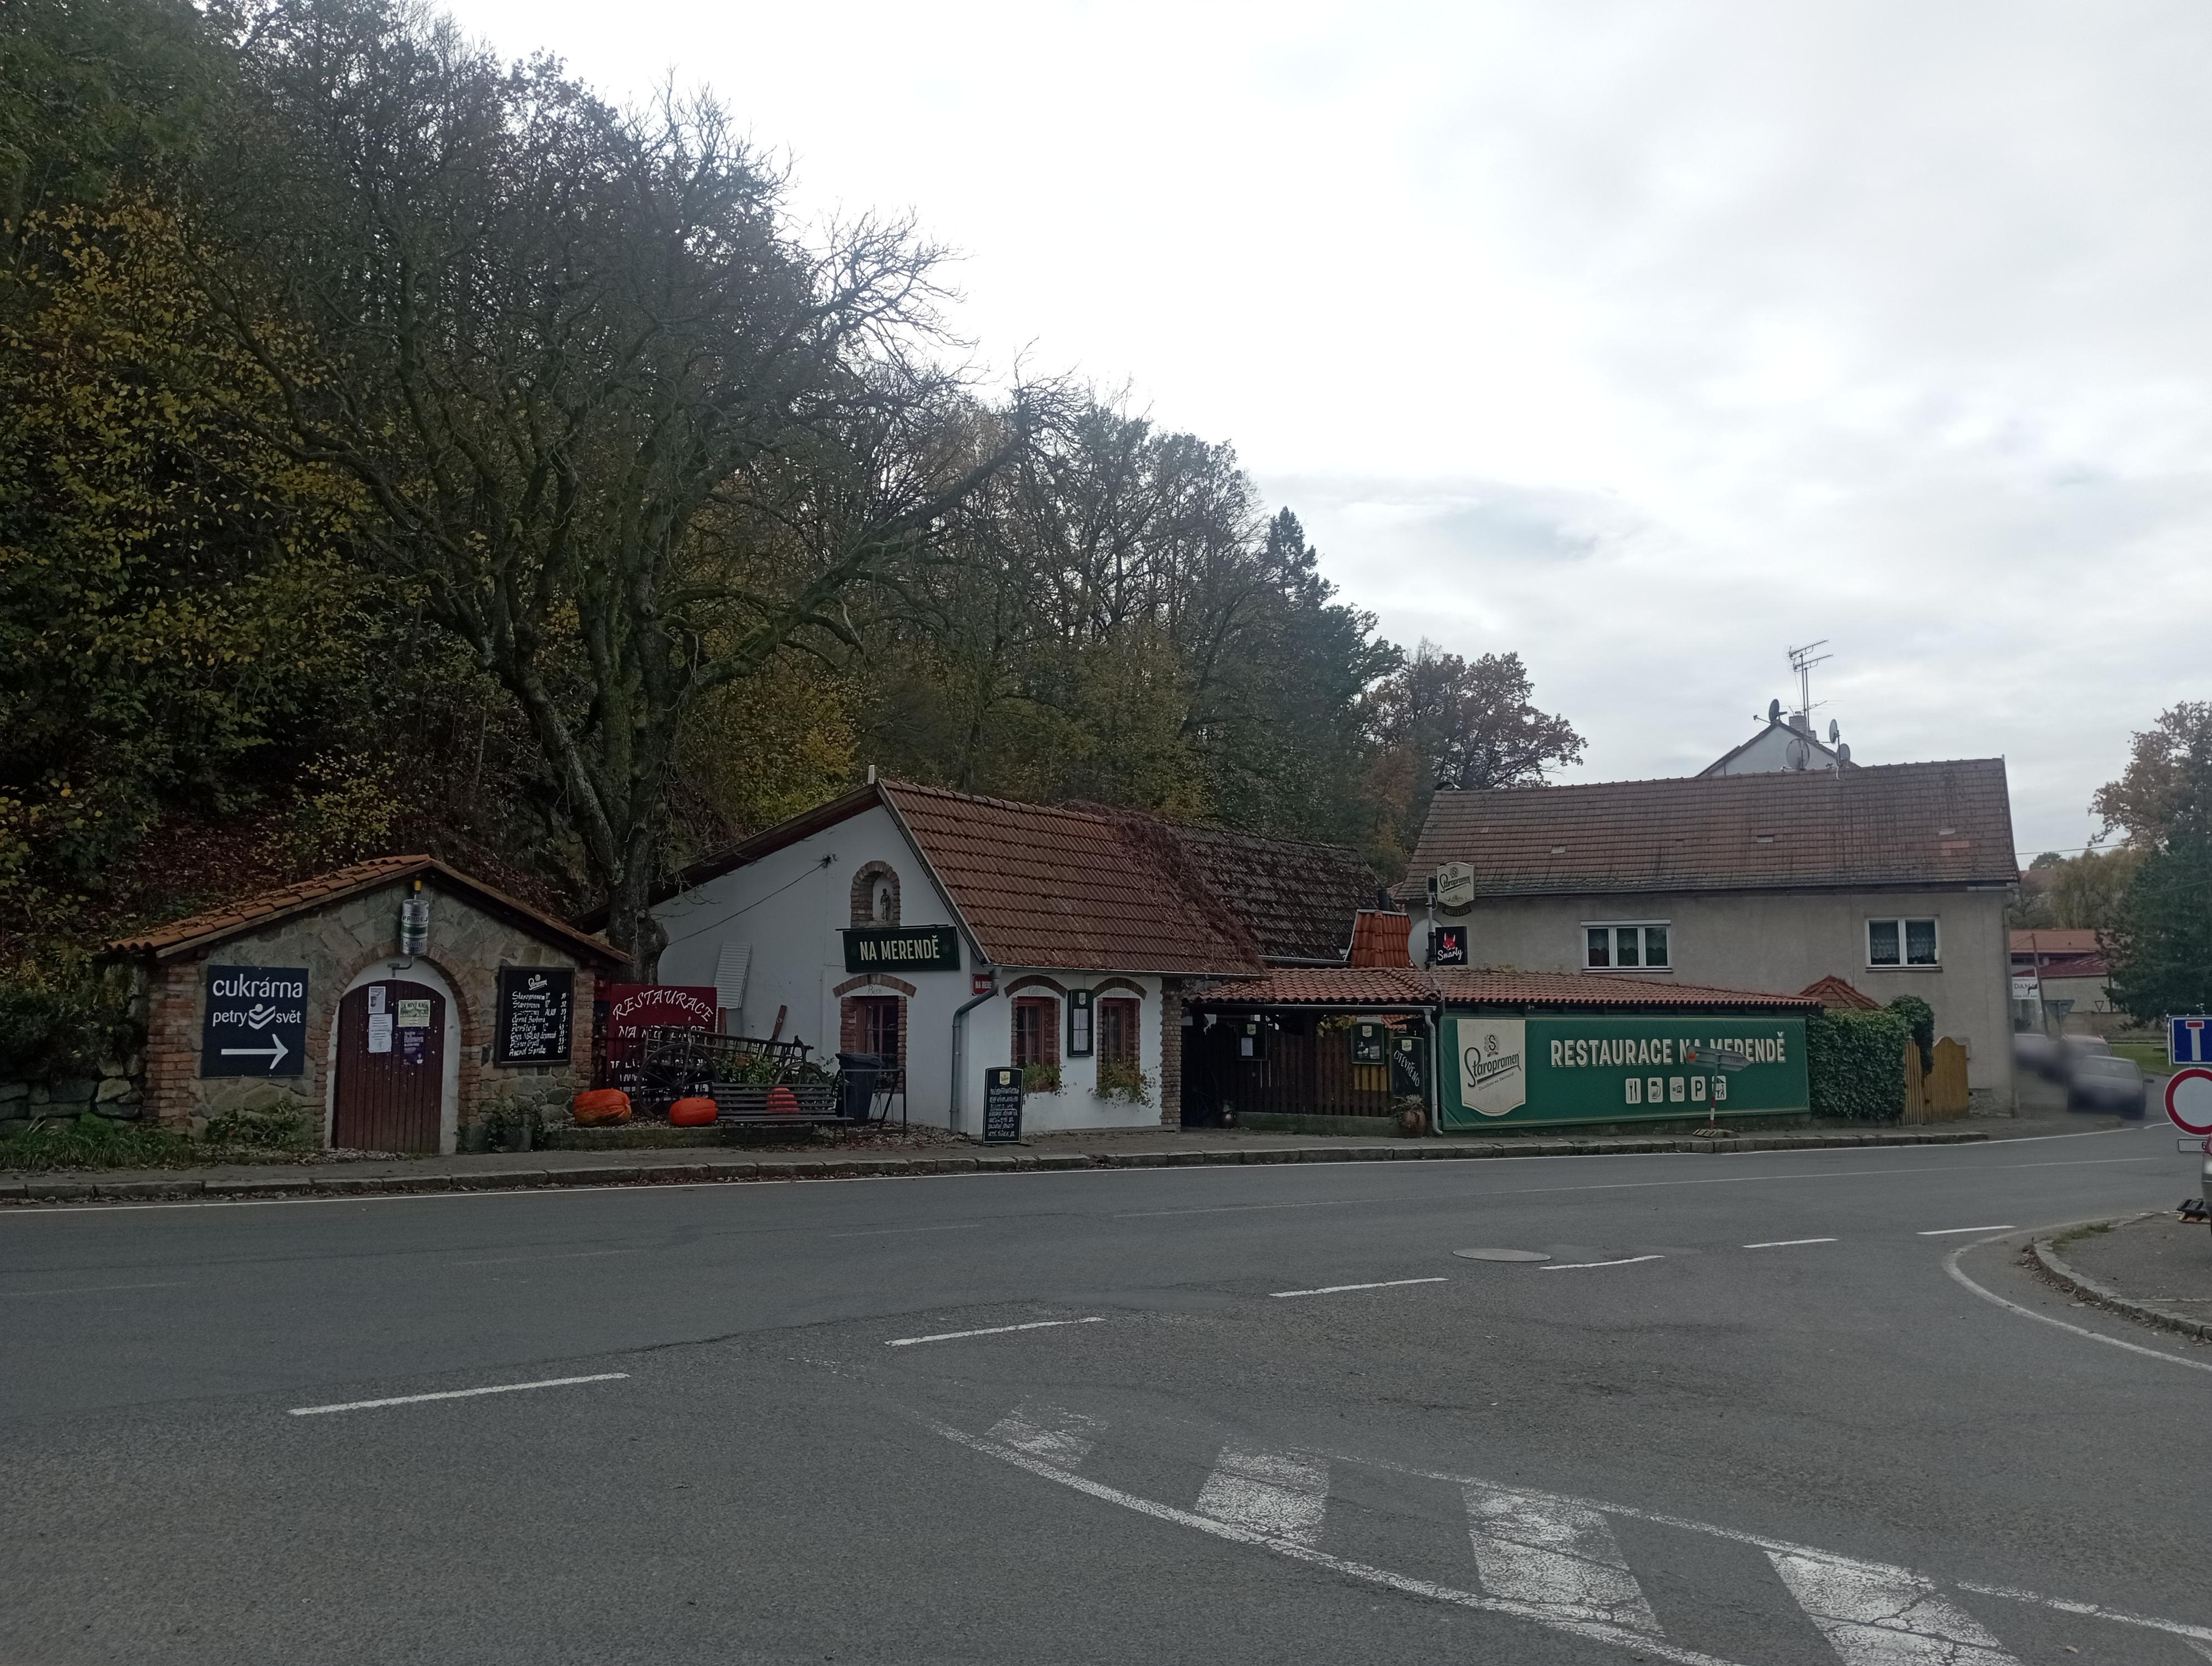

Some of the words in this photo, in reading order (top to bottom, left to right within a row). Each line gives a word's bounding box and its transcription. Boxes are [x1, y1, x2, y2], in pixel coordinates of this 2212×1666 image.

[1439, 874, 1471, 893] Staropramen
[859, 941, 877, 961] NA
[881, 935, 940, 960] MERENDĚ
[1437, 946, 1463, 961] Smarty
[213, 973, 303, 998] cukrárna
[612, 989, 713, 1022] RESTAURACE
[213, 1010, 248, 1027] petry
[275, 1010, 301, 1023] svět
[619, 1026, 636, 1038] NA
[1551, 1038, 1673, 1067] RESTAURACE
[1393, 1050, 1420, 1087] OTEVŘENO
[1464, 1047, 1522, 1088] Staropramen
[1695, 1080, 1703, 1097] P
